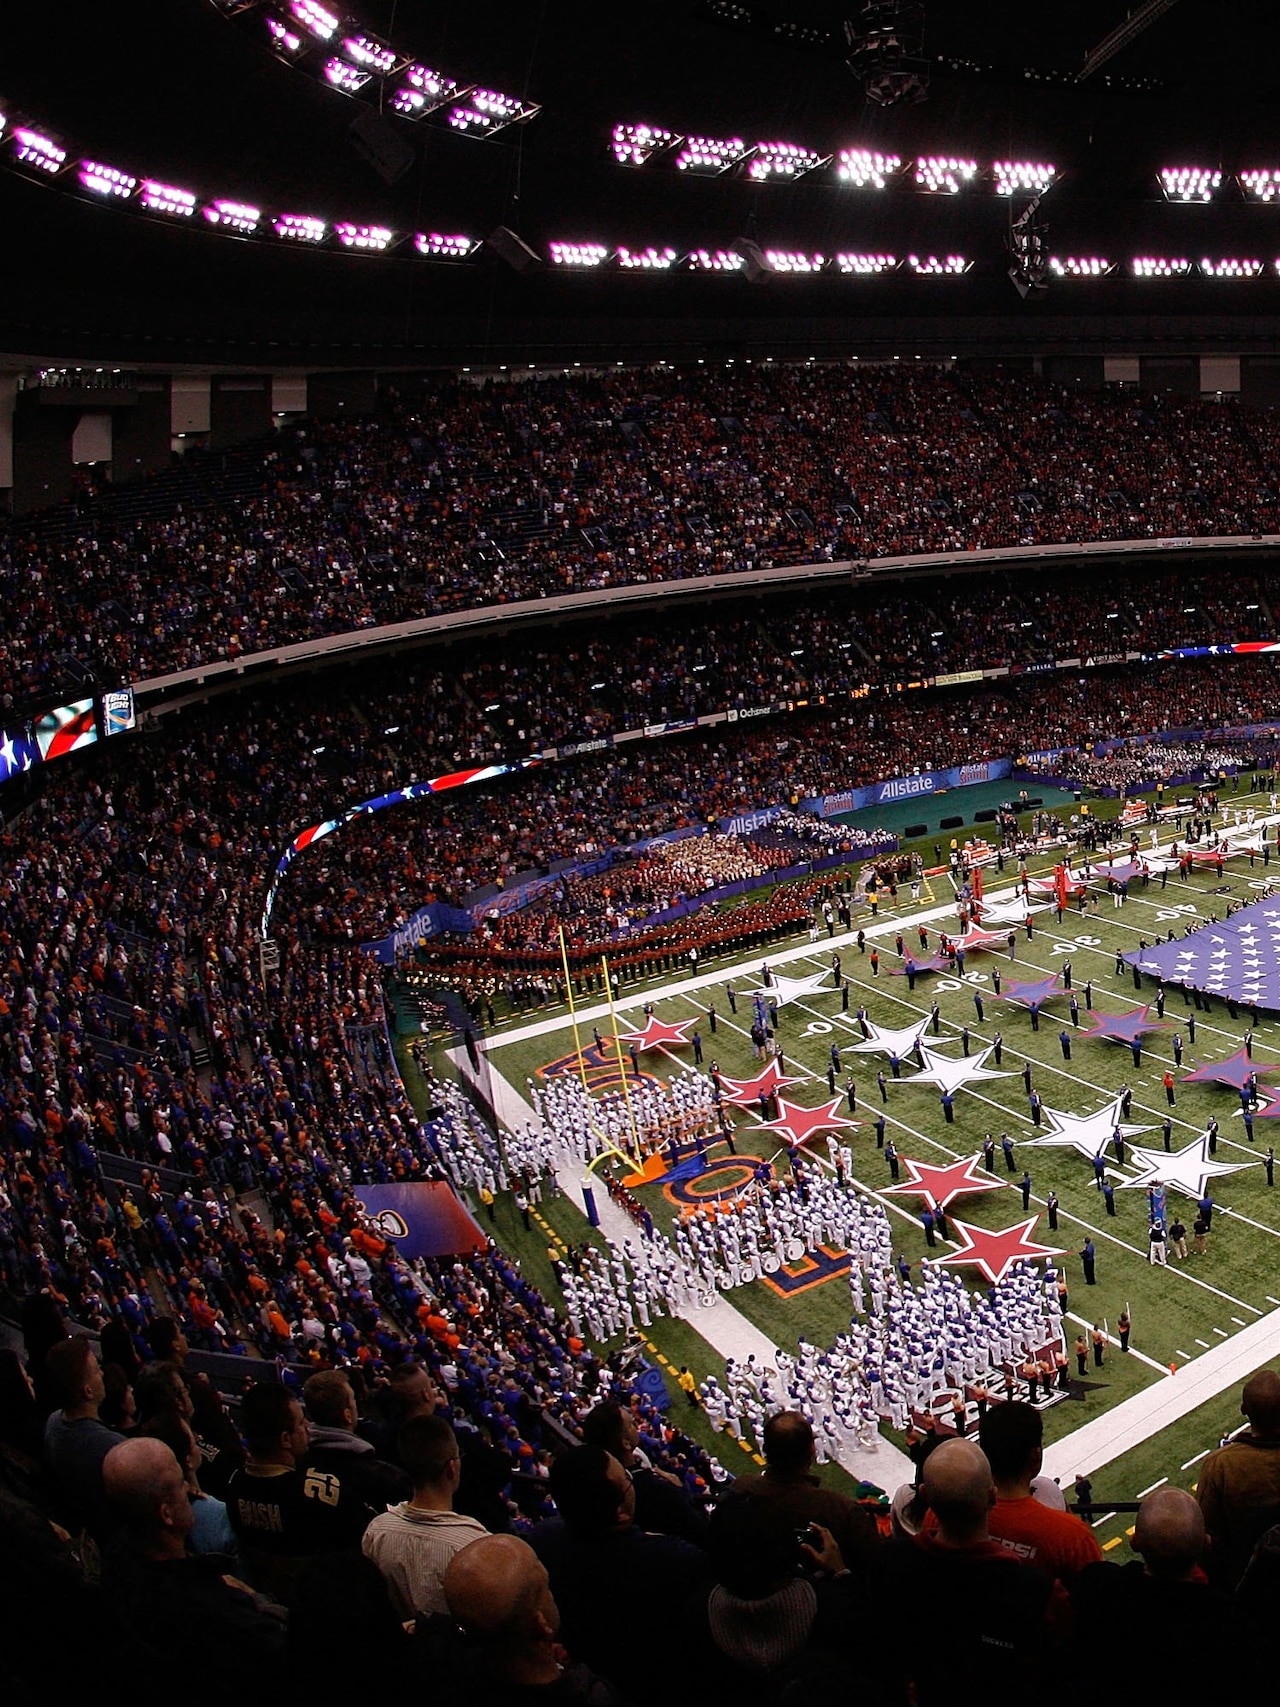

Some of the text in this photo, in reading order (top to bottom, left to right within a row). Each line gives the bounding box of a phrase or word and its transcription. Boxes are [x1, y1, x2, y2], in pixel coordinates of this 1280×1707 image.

[740, 706, 771, 718] Ochsner
[576, 739, 607, 753] Allstate
[960, 762, 988, 775] Allstate
[880, 776, 934, 800] Allstate
[824, 792, 852, 805] Allstate
[726, 806, 786, 837] Allstat
[936, 970, 990, 992] 20
[303, 1466, 341, 1508] 25
